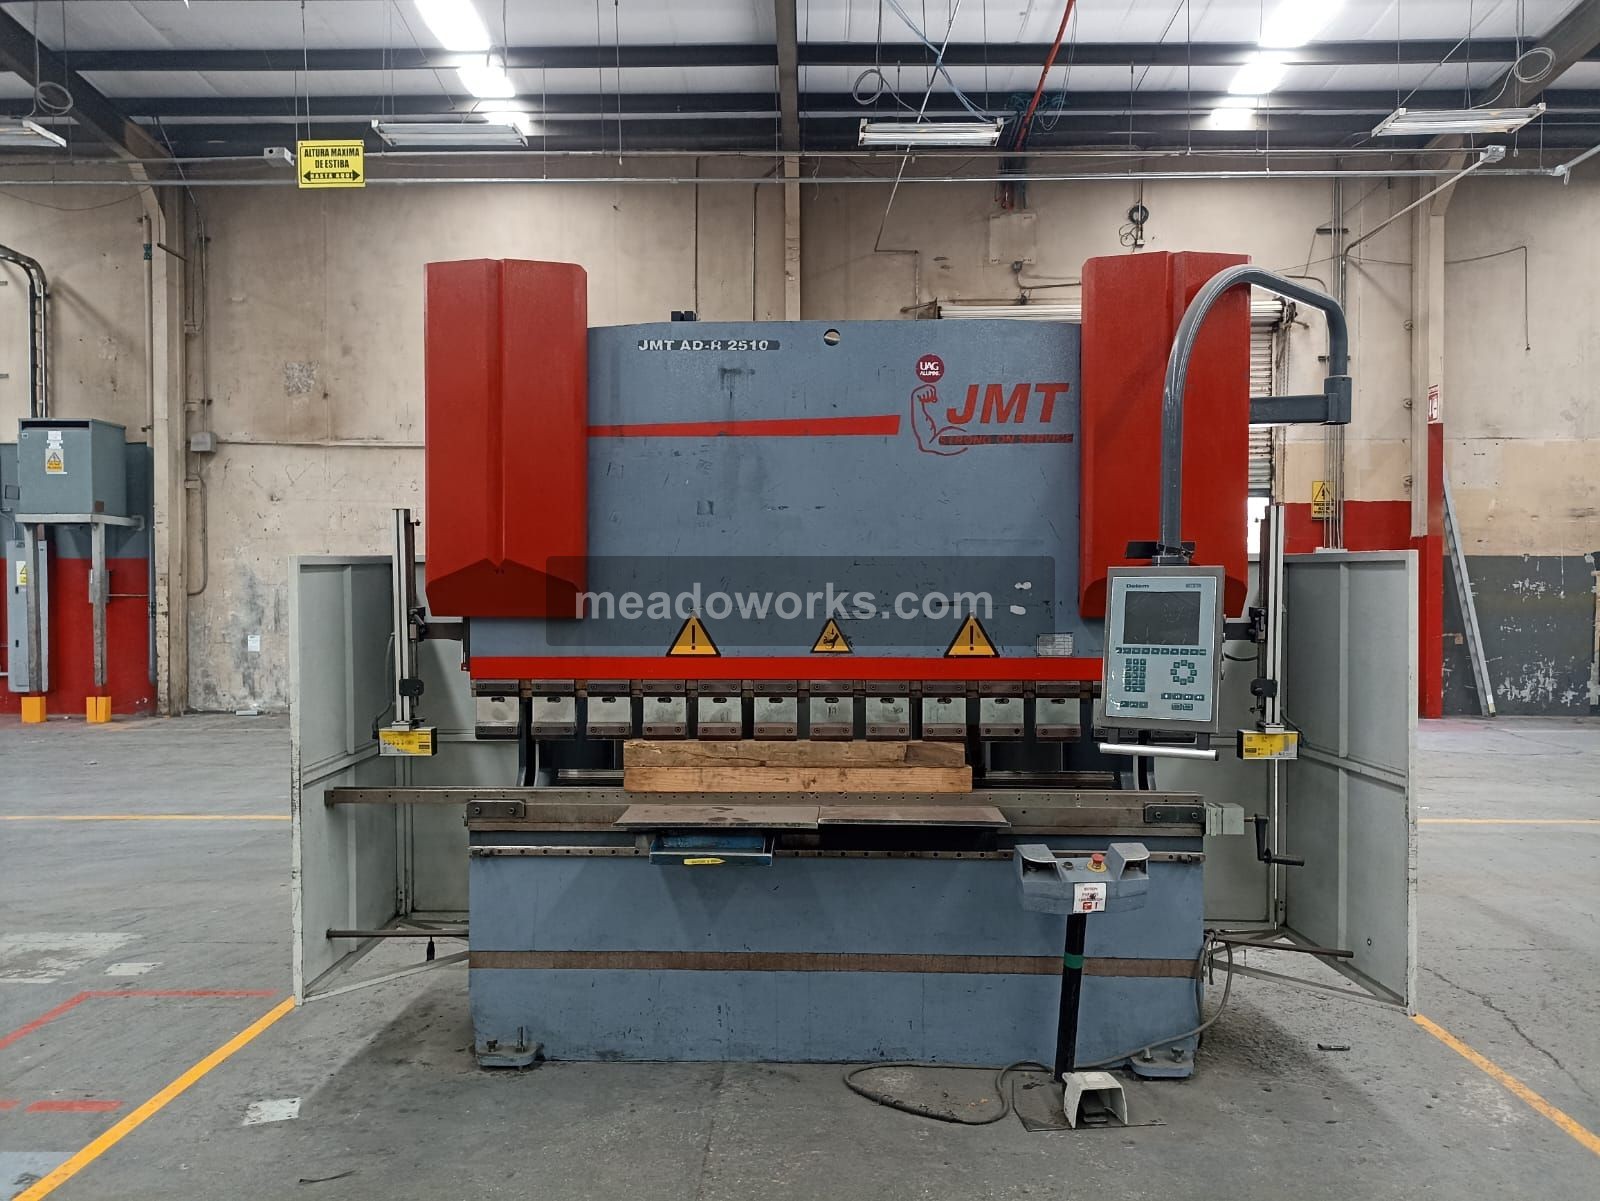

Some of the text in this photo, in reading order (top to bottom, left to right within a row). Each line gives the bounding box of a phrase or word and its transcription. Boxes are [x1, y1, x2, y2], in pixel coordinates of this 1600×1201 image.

[304, 148, 360, 157] ALTURA MAXIMA
[315, 160, 349, 168] DE ESTIBA
[638, 340, 675, 351] JMT
[727, 340, 769, 351] 2510
[920, 361, 940, 370] UAG
[946, 383, 1070, 425] JMT
